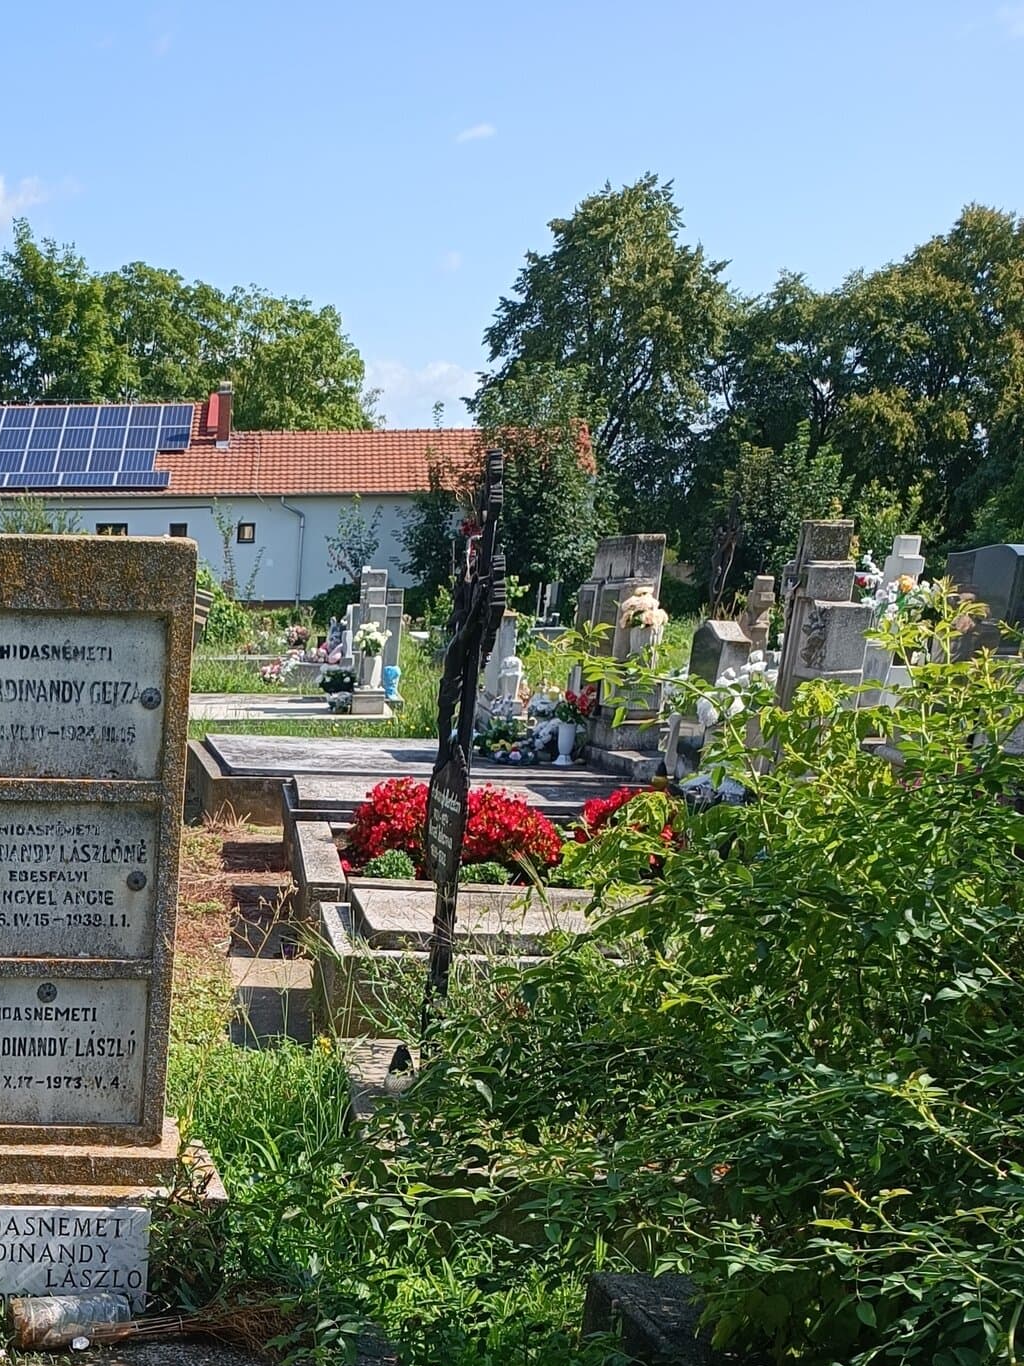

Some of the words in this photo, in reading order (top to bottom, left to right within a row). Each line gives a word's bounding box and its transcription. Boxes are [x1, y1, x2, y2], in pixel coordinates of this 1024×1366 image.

[59, 839, 148, 864] LÁSZLÓNÉ
[62, 890, 115, 906] ANGIE
[75, 1030, 137, 1058] LÁSZLÓ
